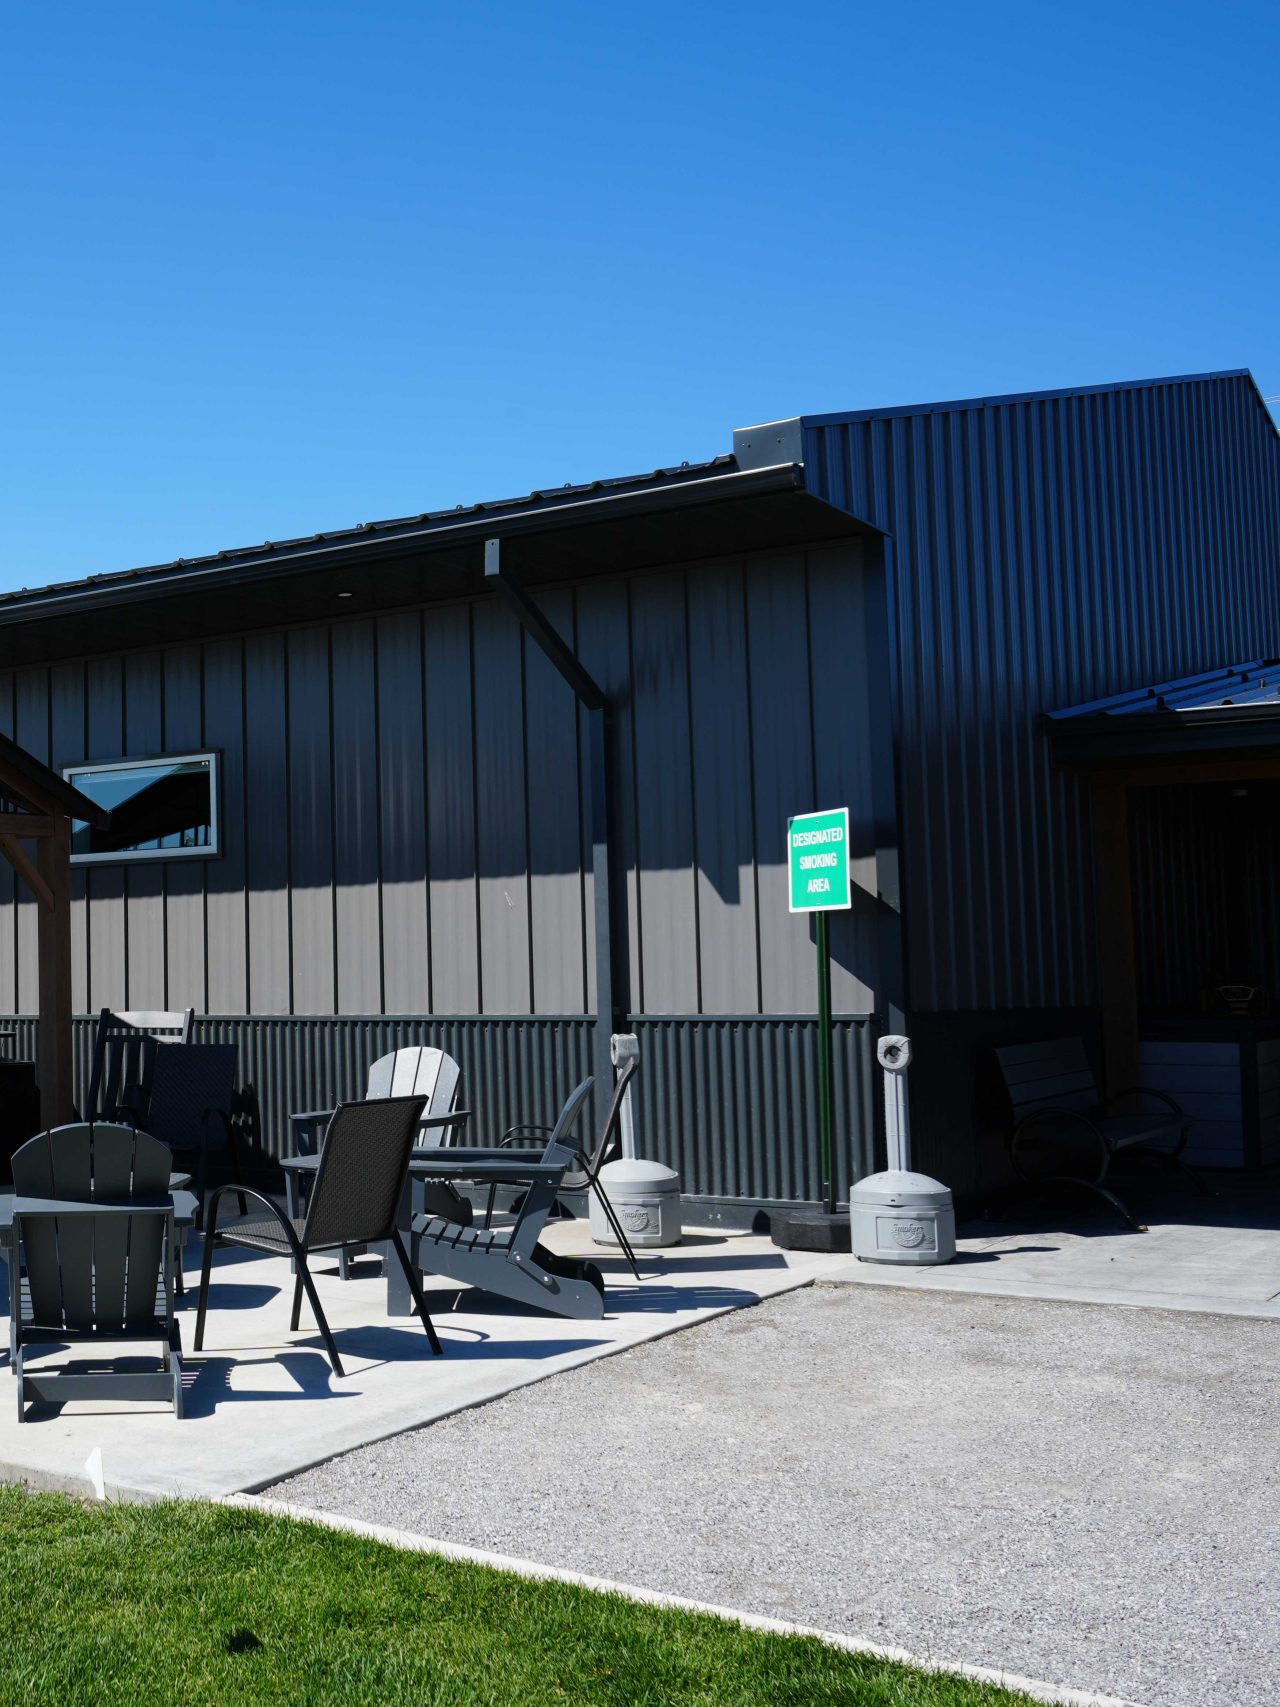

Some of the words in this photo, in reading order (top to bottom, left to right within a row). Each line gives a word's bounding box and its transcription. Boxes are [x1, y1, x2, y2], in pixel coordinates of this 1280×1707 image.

[792, 827, 843, 847] DESIGNATED
[800, 852, 837, 870] SMOKING
[807, 878, 830, 893] AREA
